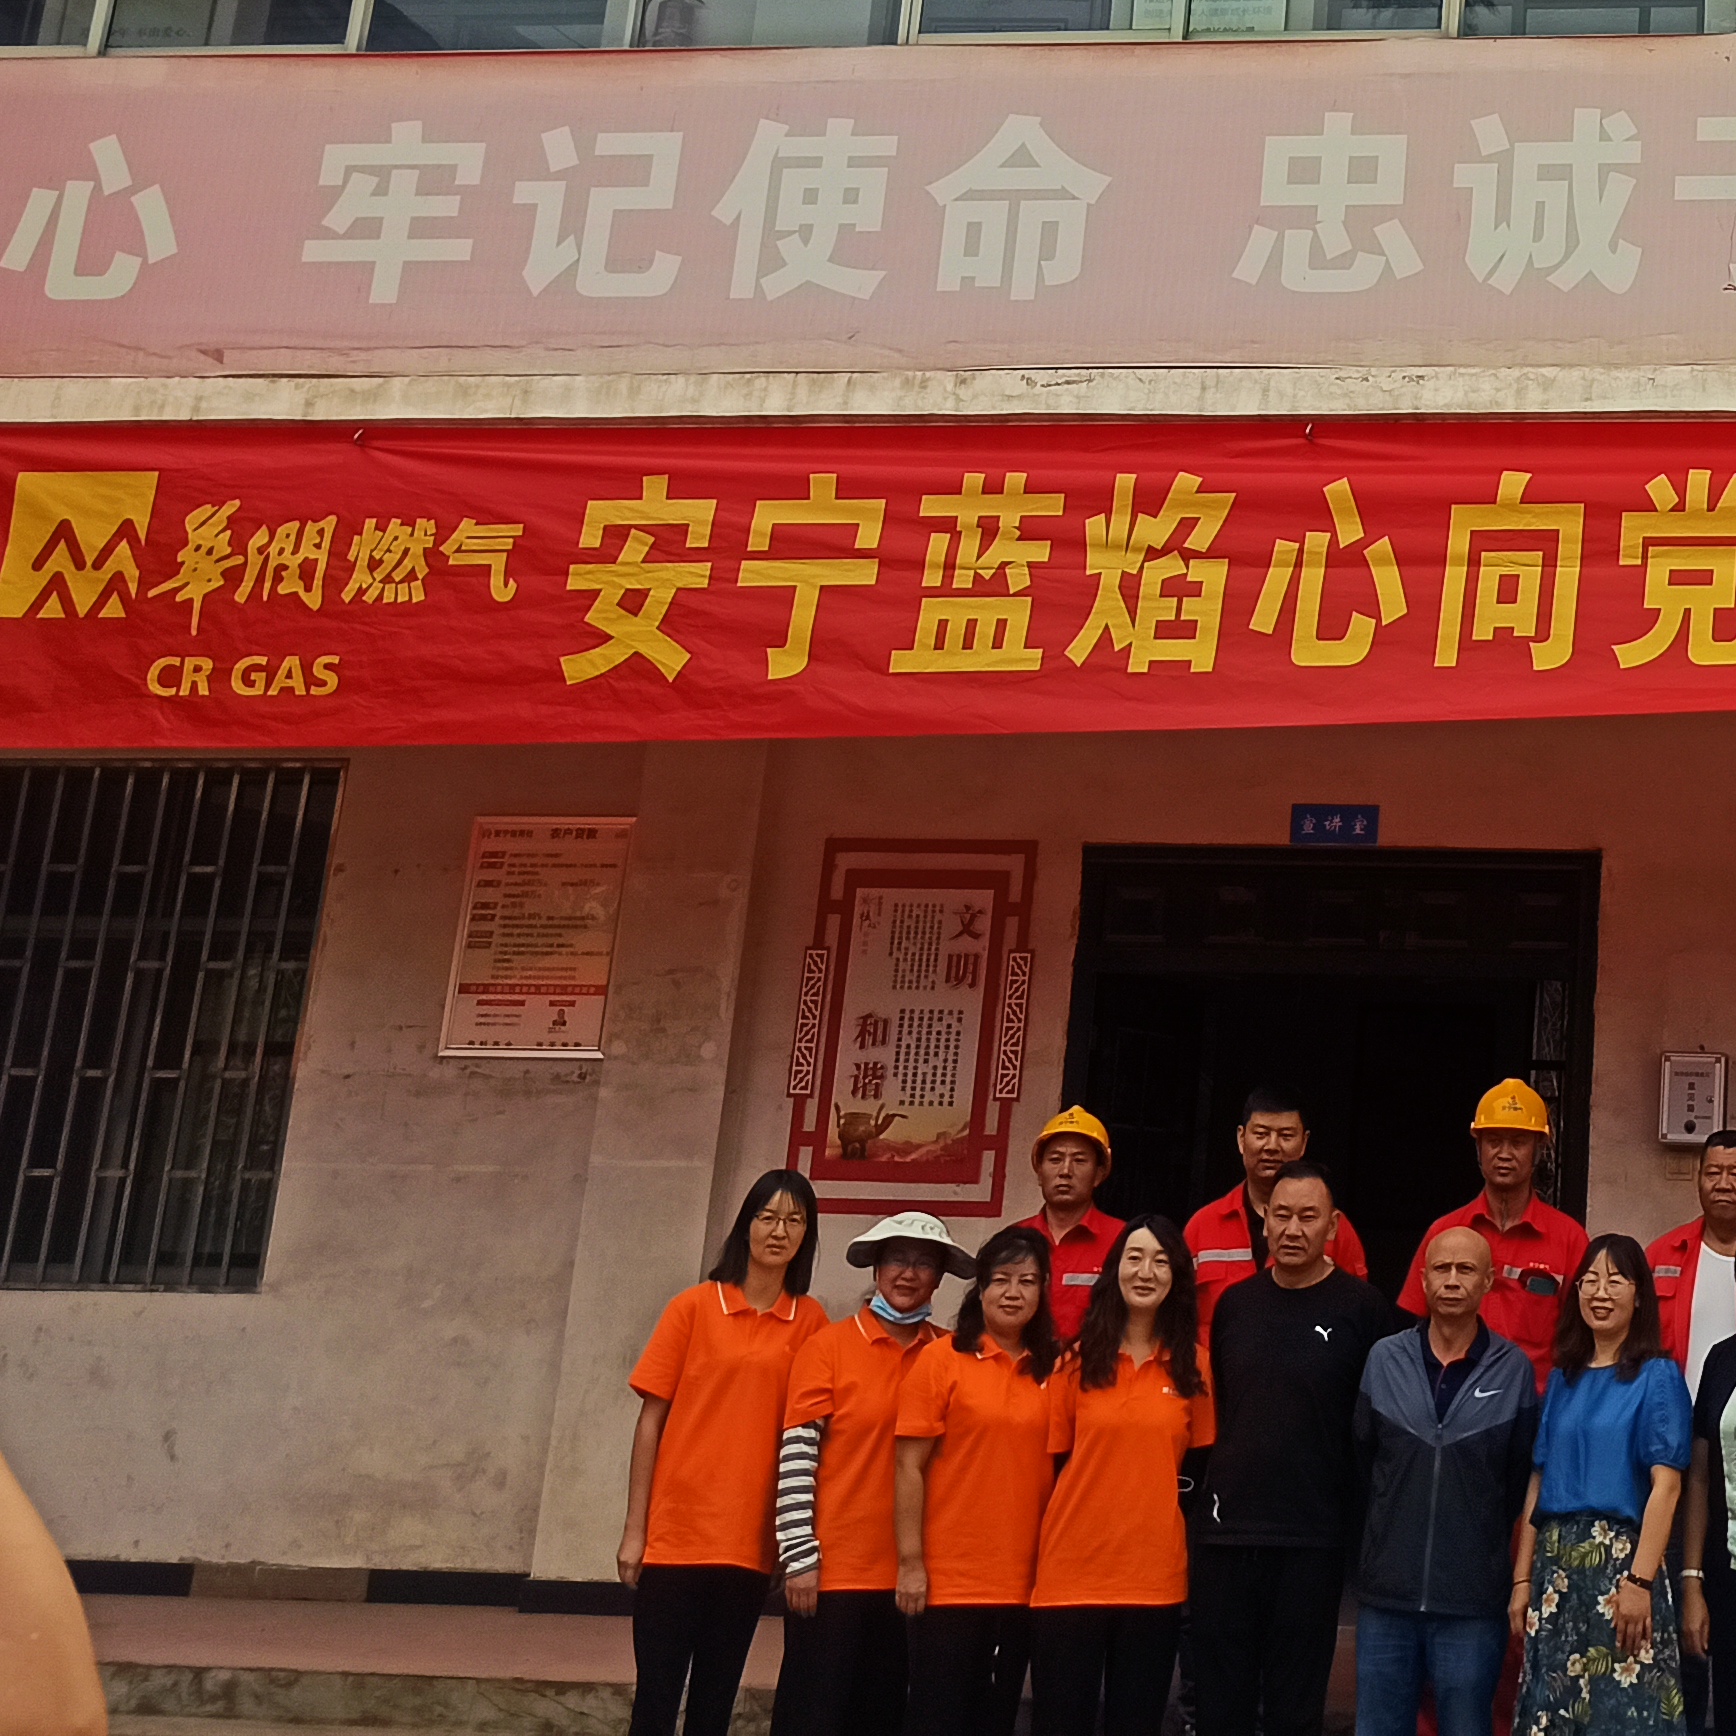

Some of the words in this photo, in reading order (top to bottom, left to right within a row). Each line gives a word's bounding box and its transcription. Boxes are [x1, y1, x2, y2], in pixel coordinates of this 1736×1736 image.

[0, 134, 178, 300] 心
[302, 114, 1112, 303] 牢记使命
[147, 655, 213, 696] CR
[230, 655, 340, 696] GAS
[1301, 813, 1368, 835] 宣讲室
[945, 904, 983, 990] 文明
[850, 1011, 890, 1101] 和谐
